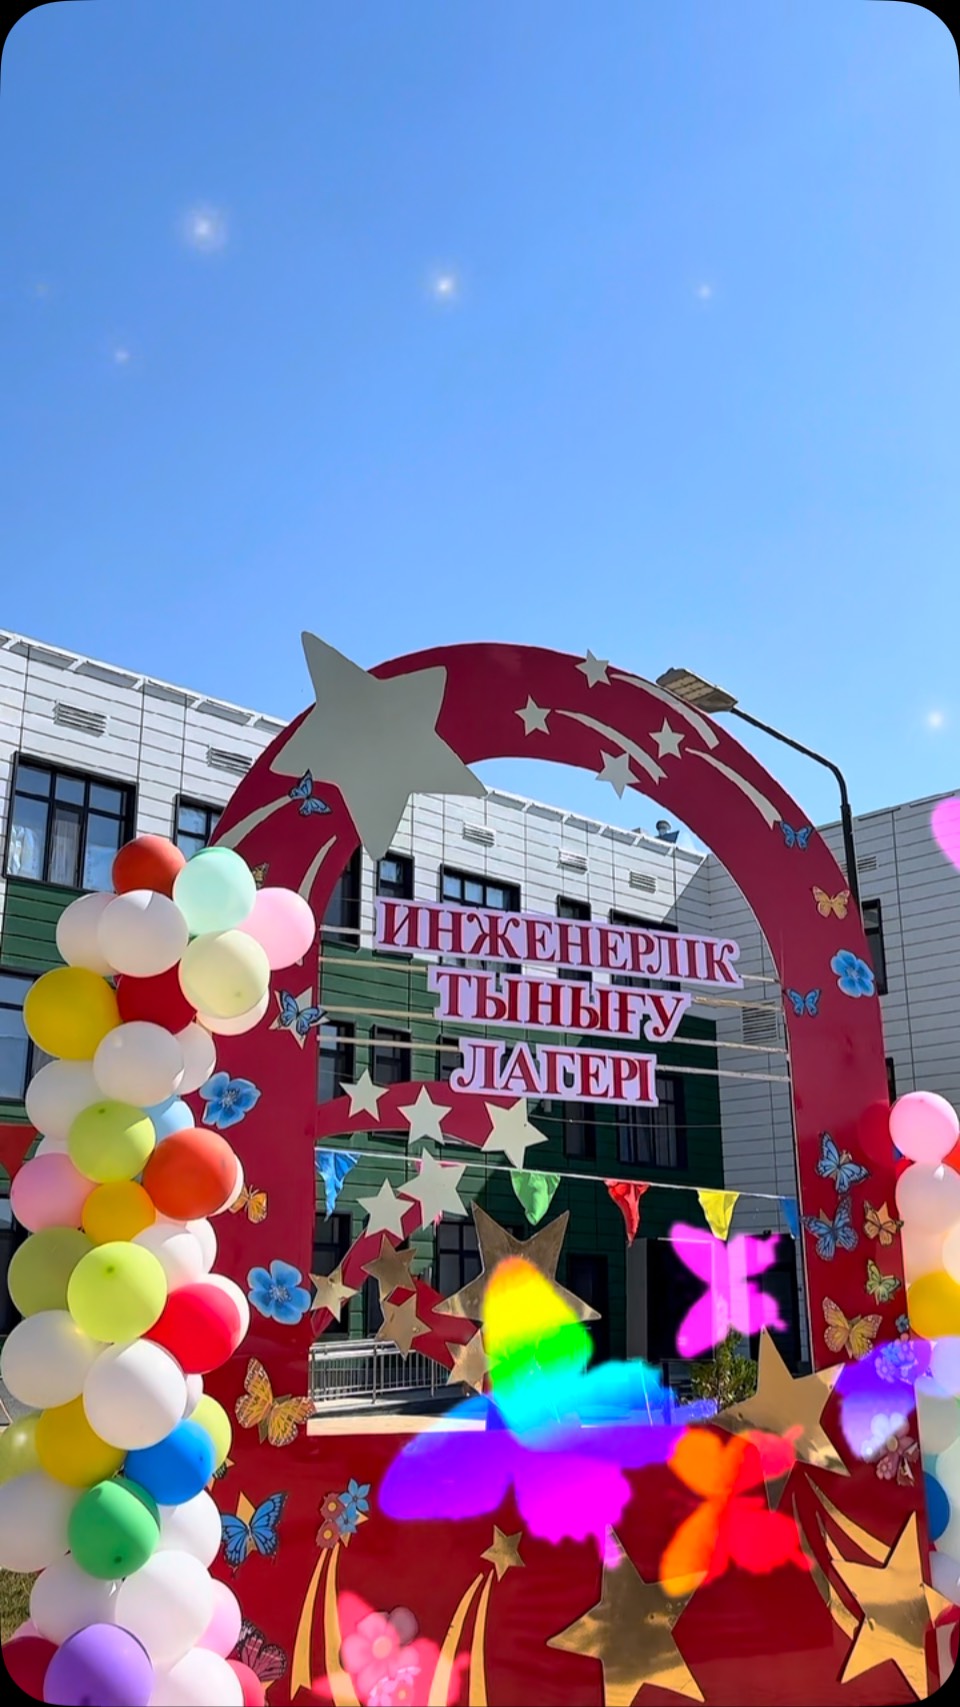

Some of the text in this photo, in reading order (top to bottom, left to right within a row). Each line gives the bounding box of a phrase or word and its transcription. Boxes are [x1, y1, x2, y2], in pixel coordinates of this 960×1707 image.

[378, 901, 738, 983] ИНЖЕНЕРЛІК
[435, 971, 685, 1038] ТЫНЫҒУ
[456, 1043, 655, 1102] ЛАГЕРІ
